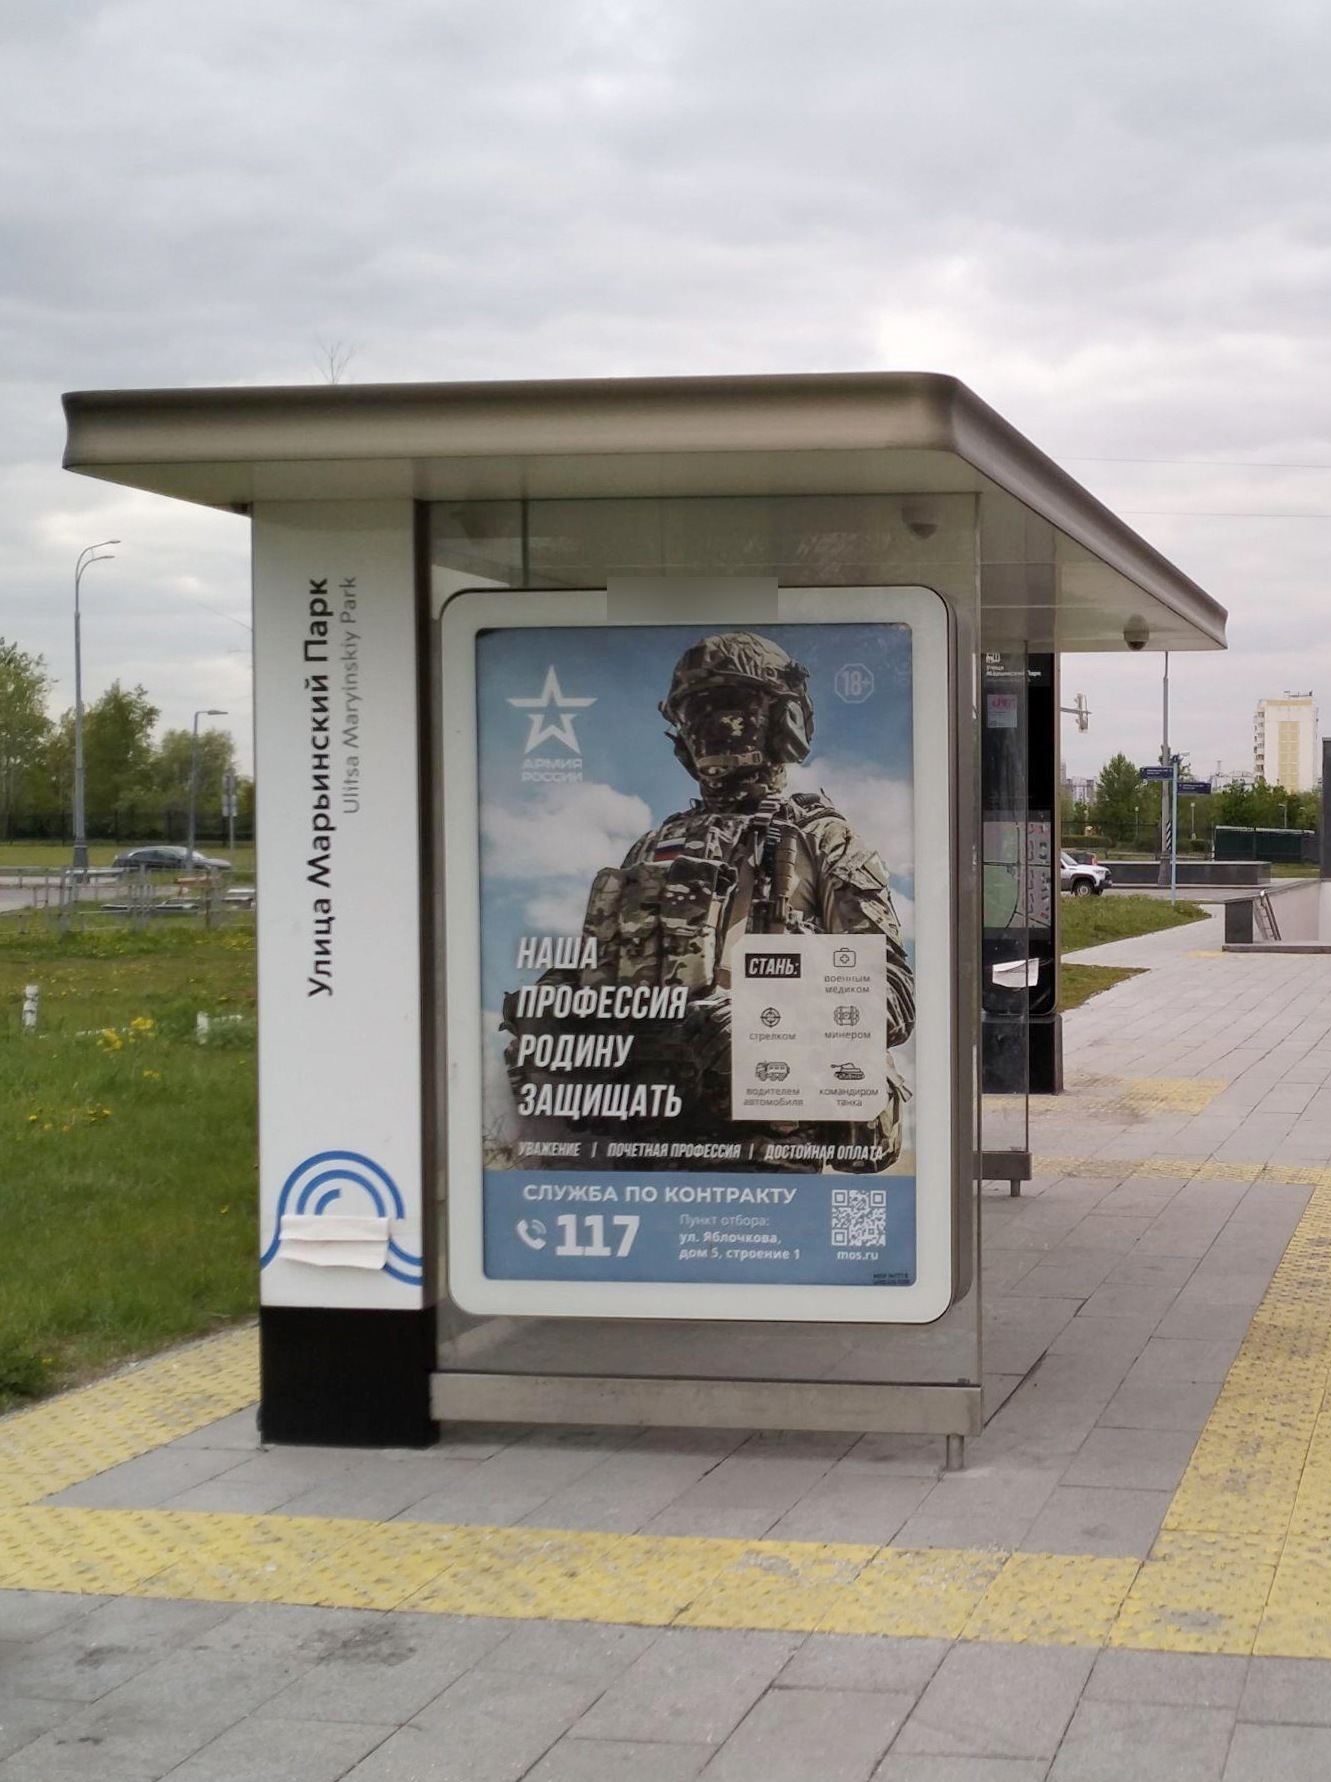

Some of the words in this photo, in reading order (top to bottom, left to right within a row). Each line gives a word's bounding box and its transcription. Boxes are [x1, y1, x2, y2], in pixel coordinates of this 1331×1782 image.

[339, 576, 356, 624] Park
[303, 577, 332, 662] Парк
[341, 630, 363, 748] Maryinskiy
[841, 671, 870, 696] 18+
[522, 758, 582, 769] АРМИЯ
[304, 673, 334, 888] Марьинский
[342, 755, 360, 814] Ulitsa
[521, 771, 582, 782] РОССИИ
[308, 898, 333, 997] Улица
[516, 936, 599, 970] НАША
[748, 957, 799, 975] СТАНЬ:
[516, 984, 689, 1019] ПРОФЕССИЯ
[749, 1033, 796, 1042] стрелком
[516, 1033, 635, 1072] РОДИНУ
[746, 1088, 800, 1096] водителем
[819, 1088, 879, 1096] командиром
[518, 1082, 683, 1121] ЗАЩИЩАТЬ
[743, 1098, 804, 1106] автомобиля
[836, 1099, 862, 1107] танка
[518, 1141, 582, 1157] УВАЖЕНИЕ
[606, 1142, 668, 1157] ПОЧЕТНАЯ
[670, 1143, 741, 1158] ПРОФЕССИЯ
[763, 1143, 835, 1161] ДОСТОЙНАЯ
[837, 1145, 883, 1160] ОПЛАТА
[523, 1184, 618, 1203] СЛУЖБА
[625, 1186, 658, 1202] ПО
[665, 1187, 798, 1204] КОНТРАКТУ
[680, 1213, 717, 1228] Пункт
[721, 1214, 770, 1228] отбора:
[555, 1214, 640, 1257] 117
[679, 1233, 700, 1244] ул.
[703, 1231, 782, 1244] Яблочкова,
[679, 1249, 708, 1259] дом
[726, 1249, 790, 1261] строение
[793, 1249, 800, 1259] 1
[837, 1251, 879, 1260] mos.ru
